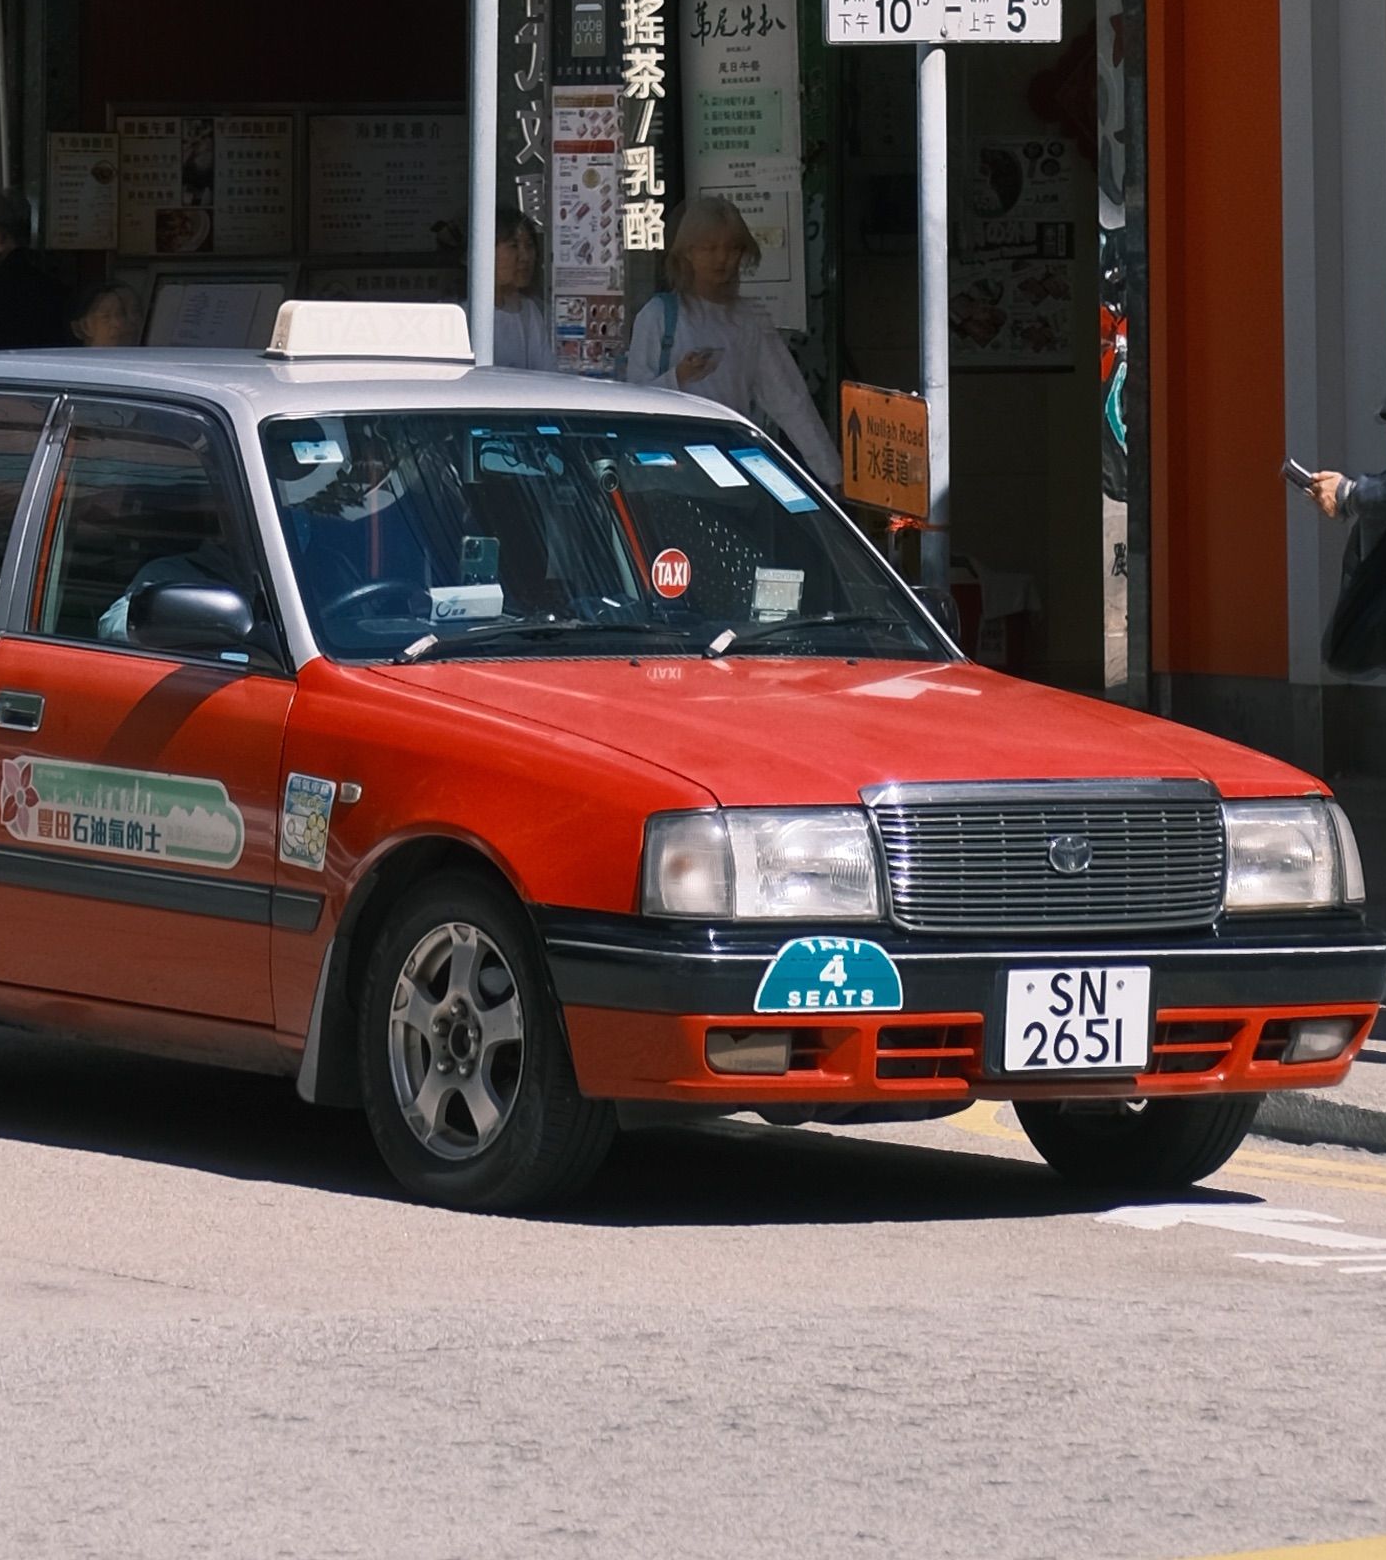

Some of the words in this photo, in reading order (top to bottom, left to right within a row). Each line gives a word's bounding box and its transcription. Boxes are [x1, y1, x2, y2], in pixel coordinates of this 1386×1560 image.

[838, 13, 870, 34] 下午
[969, 12, 996, 33] 上午
[866, 416, 898, 441] Nullah
[899, 423, 924, 448] Road
[867, 441, 910, 487] 水渠道
[656, 560, 689, 588] TAXI
[37, 807, 162, 854] 豐田石油氣的士
[818, 954, 848, 987] 4
[787, 988, 875, 1007] SEATS
[1048, 970, 1108, 1018] SN
[1023, 1018, 1123, 1067] 2651
